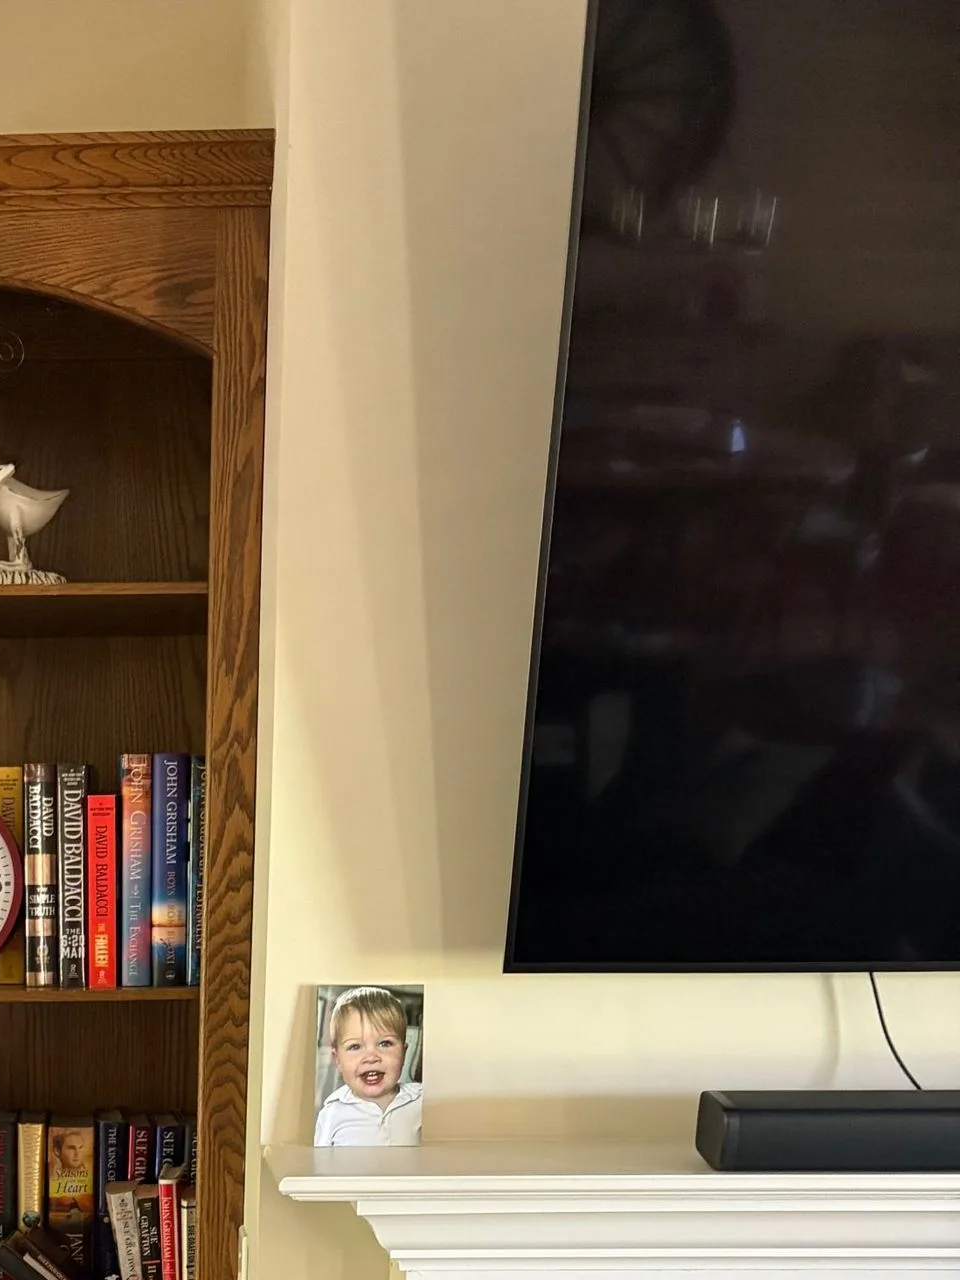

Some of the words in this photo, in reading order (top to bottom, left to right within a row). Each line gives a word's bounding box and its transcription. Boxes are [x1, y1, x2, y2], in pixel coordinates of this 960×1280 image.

[130, 762, 146, 803] JOHN
[165, 760, 177, 798] JOHN
[29, 785, 41, 849] BALDACCI
[42, 796, 54, 837] DAVID
[64, 789, 82, 839] DAVID
[95, 825, 107, 859] DAVID
[166, 801, 177, 864] GRISHAM
[130, 810, 146, 881] GRISHAM
[64, 843, 82, 922] BALDACCI
[95, 862, 109, 918] BALDACCI
[167, 871, 176, 896] BOYS
[29, 894, 55, 904] SIMPLE
[29, 906, 56, 916] TRUTH
[129, 902, 141, 921] THE
[61, 935, 85, 947] 6:20
[62, 947, 85, 959] MAN
[129, 926, 140, 976] EXCHANGE
[108, 1128, 117, 1145] THE
[136, 1130, 148, 1154] SUE
[163, 1131, 174, 1155] SUE
[107, 1147, 117, 1171] KING
[55, 1167, 89, 1179] Seasons
[56, 1183, 88, 1194] Heart
[162, 1196, 172, 1221] JOHN
[141, 1216, 150, 1256] GRAFTON
[149, 1226, 158, 1244] SUE
[163, 1222, 172, 1260] GRISHAM
[148, 1265, 156, 1273] H
